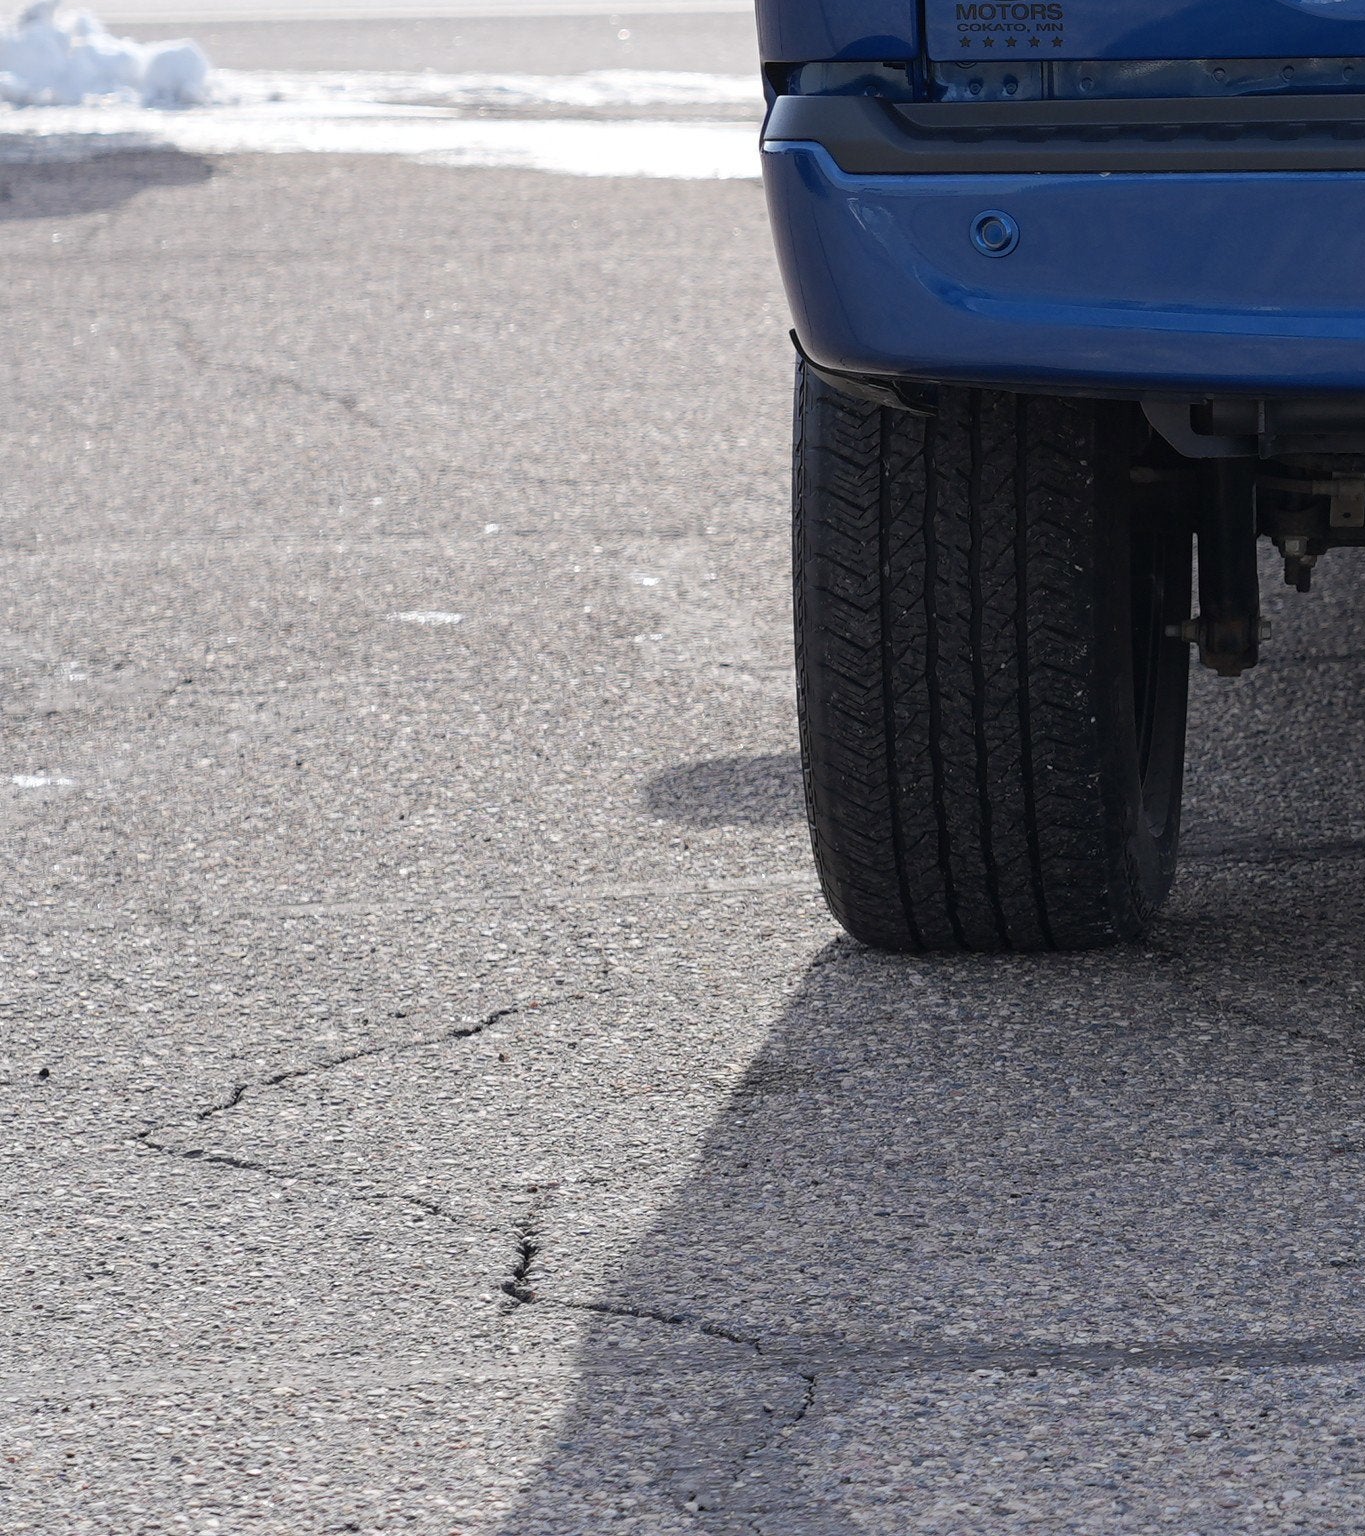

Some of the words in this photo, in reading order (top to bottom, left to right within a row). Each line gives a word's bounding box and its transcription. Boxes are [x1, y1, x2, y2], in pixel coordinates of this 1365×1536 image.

[956, 4, 1064, 20] MOTORS
[957, 23, 1031, 32] COKATO,
[1036, 23, 1063, 31] MN
